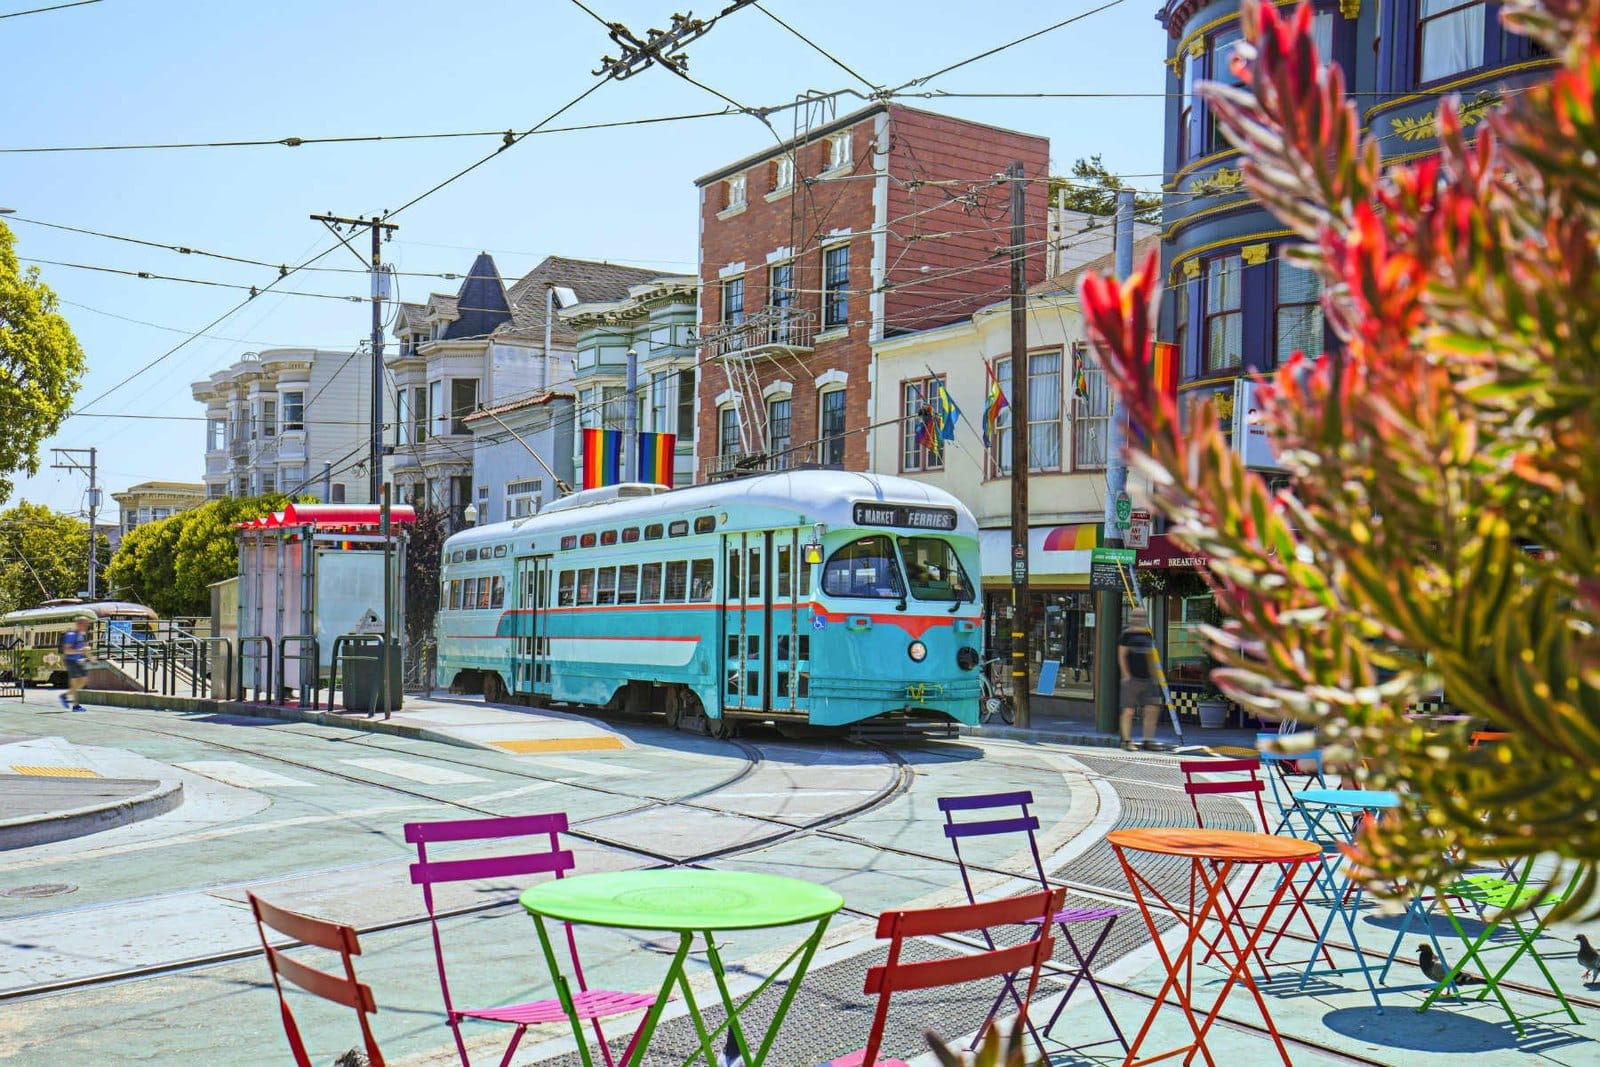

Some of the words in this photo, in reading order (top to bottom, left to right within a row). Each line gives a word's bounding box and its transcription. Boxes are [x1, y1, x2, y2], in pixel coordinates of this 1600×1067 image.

[857, 509, 862, 522] F
[865, 510, 894, 525] MARKET
[908, 512, 949, 528] FERRIES
[1168, 557, 1207, 567] BREAKFAST
